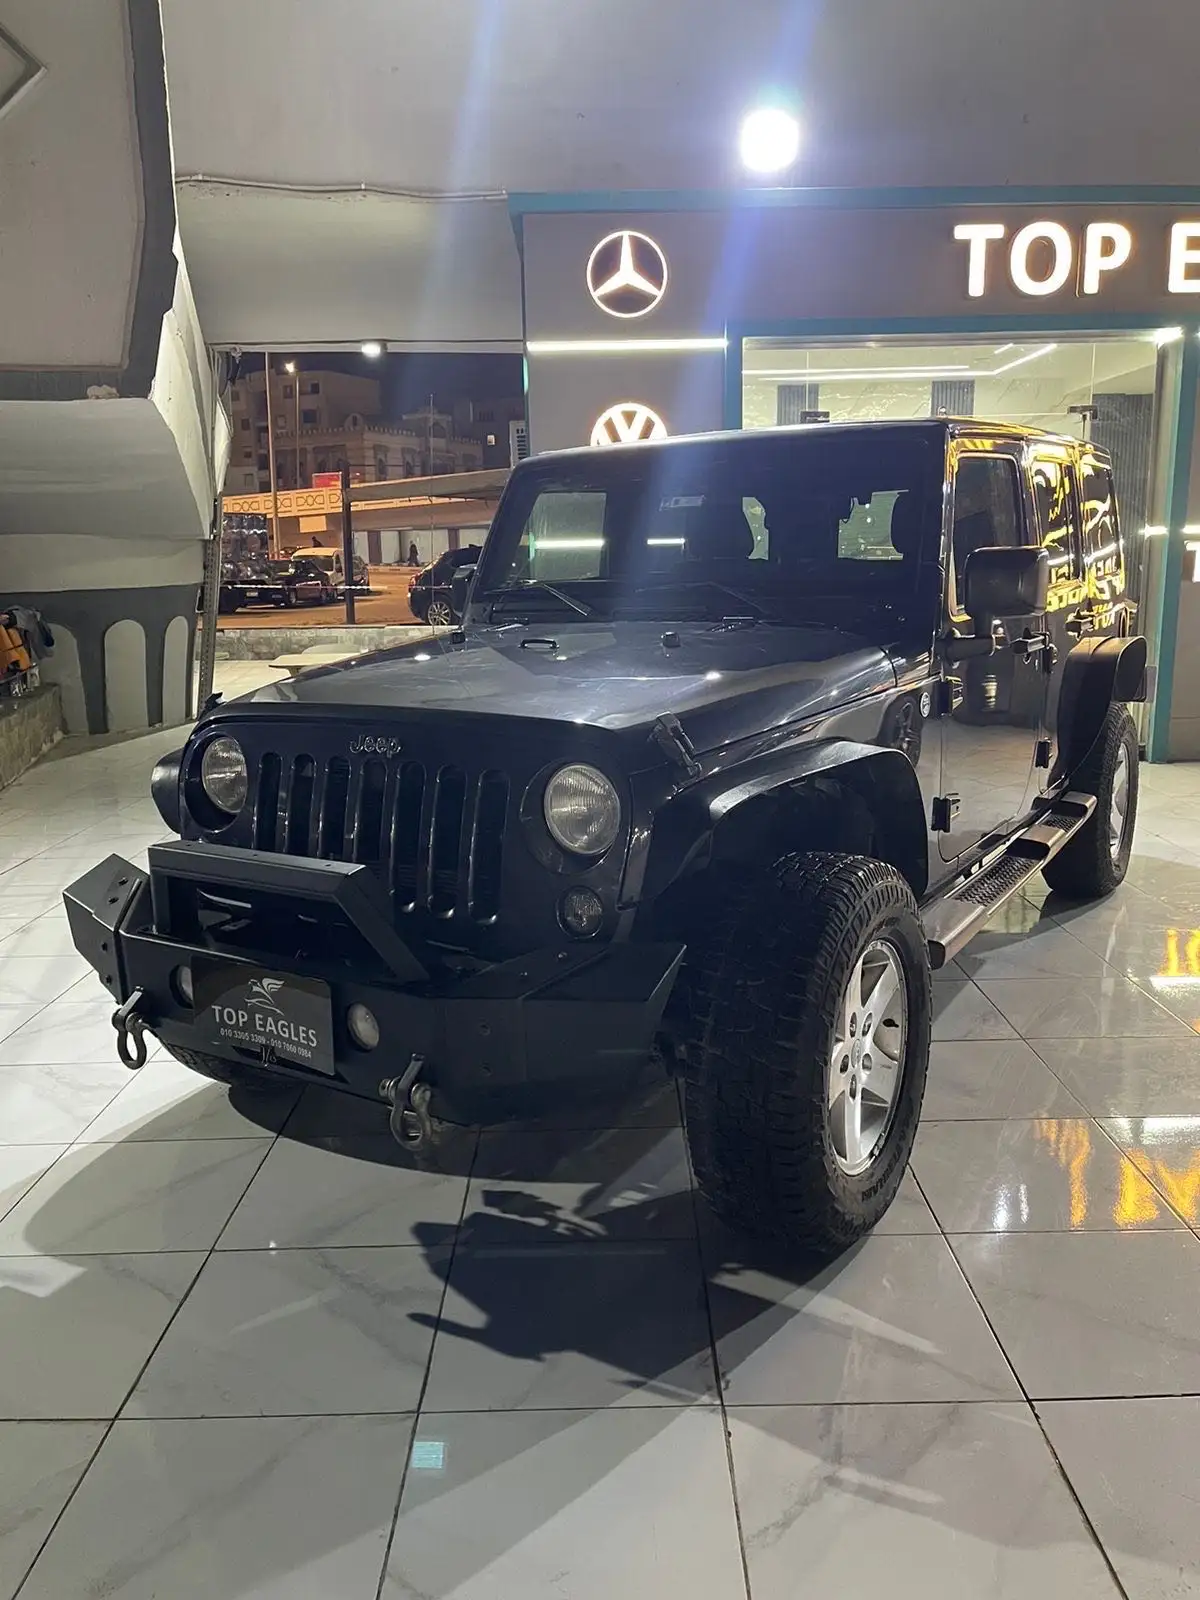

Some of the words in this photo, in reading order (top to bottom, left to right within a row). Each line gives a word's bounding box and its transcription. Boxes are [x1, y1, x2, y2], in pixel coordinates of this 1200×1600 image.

[953, 221, 1132, 297] TOP
[349, 735, 401, 758] Jeep
[211, 1005, 248, 1027] TOP
[255, 1014, 317, 1047] EAGLES
[220, 1027, 232, 1037] 010
[270, 1038, 282, 1048] 010
